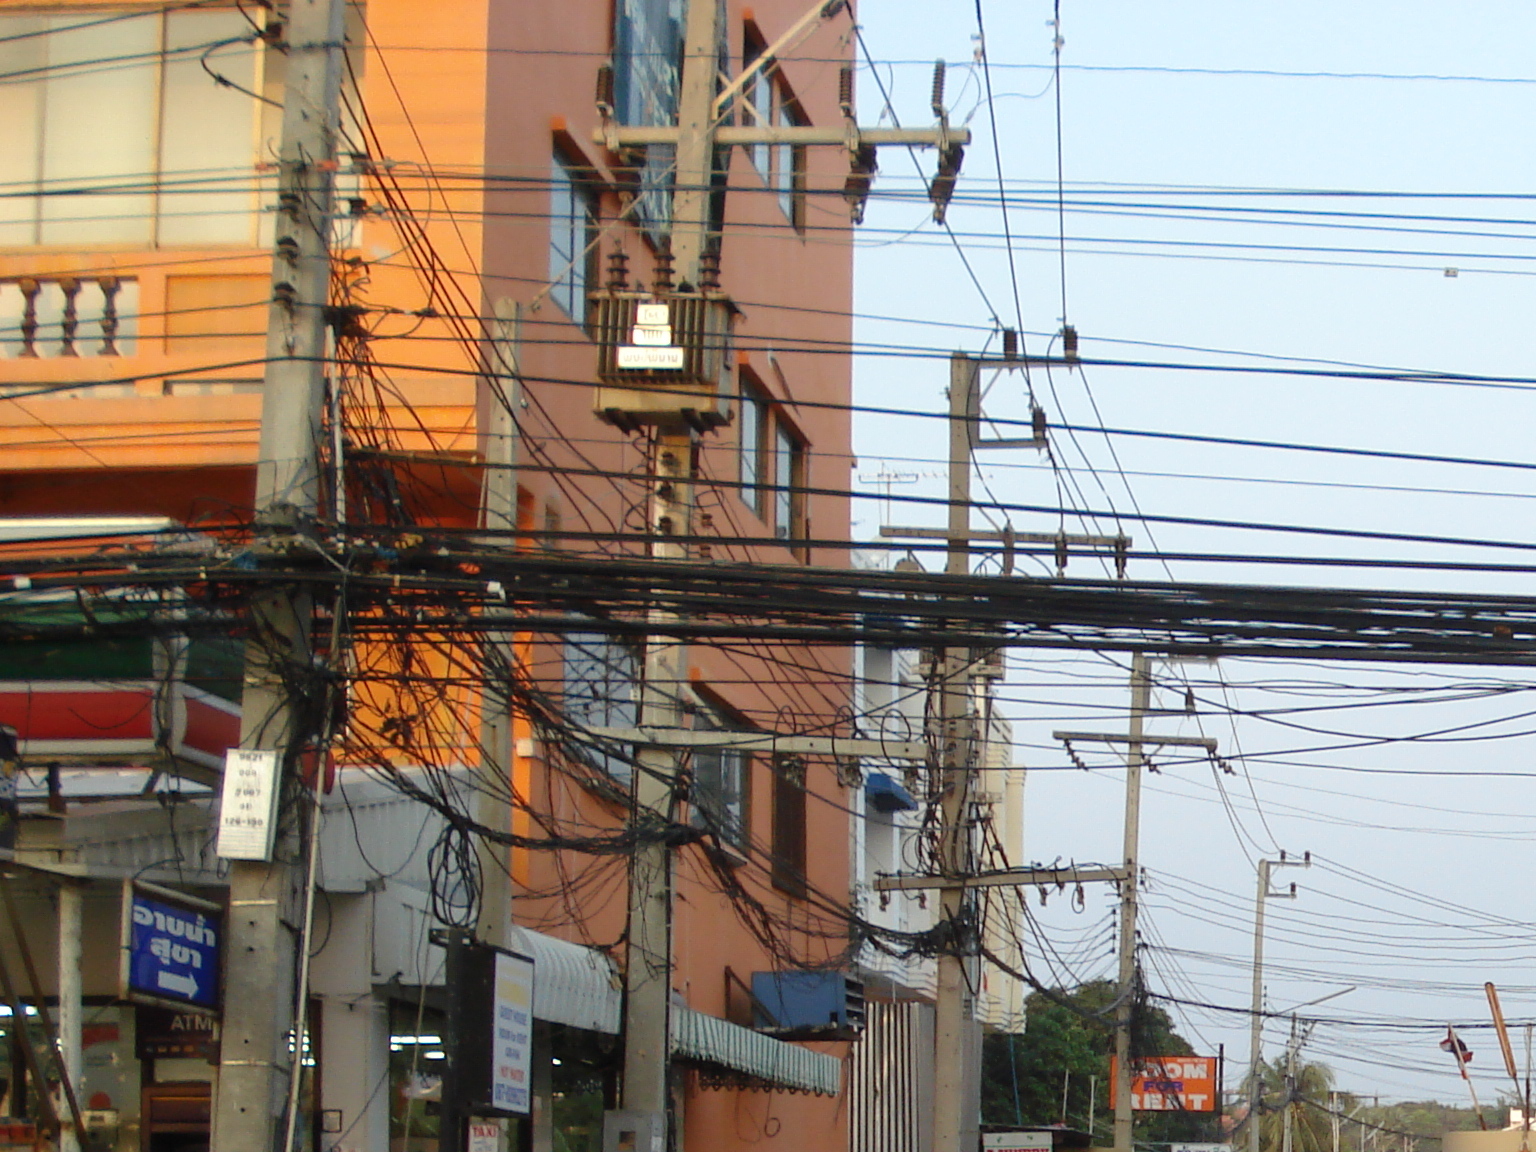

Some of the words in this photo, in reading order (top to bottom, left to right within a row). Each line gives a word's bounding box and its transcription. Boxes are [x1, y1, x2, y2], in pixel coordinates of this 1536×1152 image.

[133, 905, 216, 948] อาบน้ำ
[150, 937, 203, 970] สุขา
[170, 1013, 213, 1031] ATM
